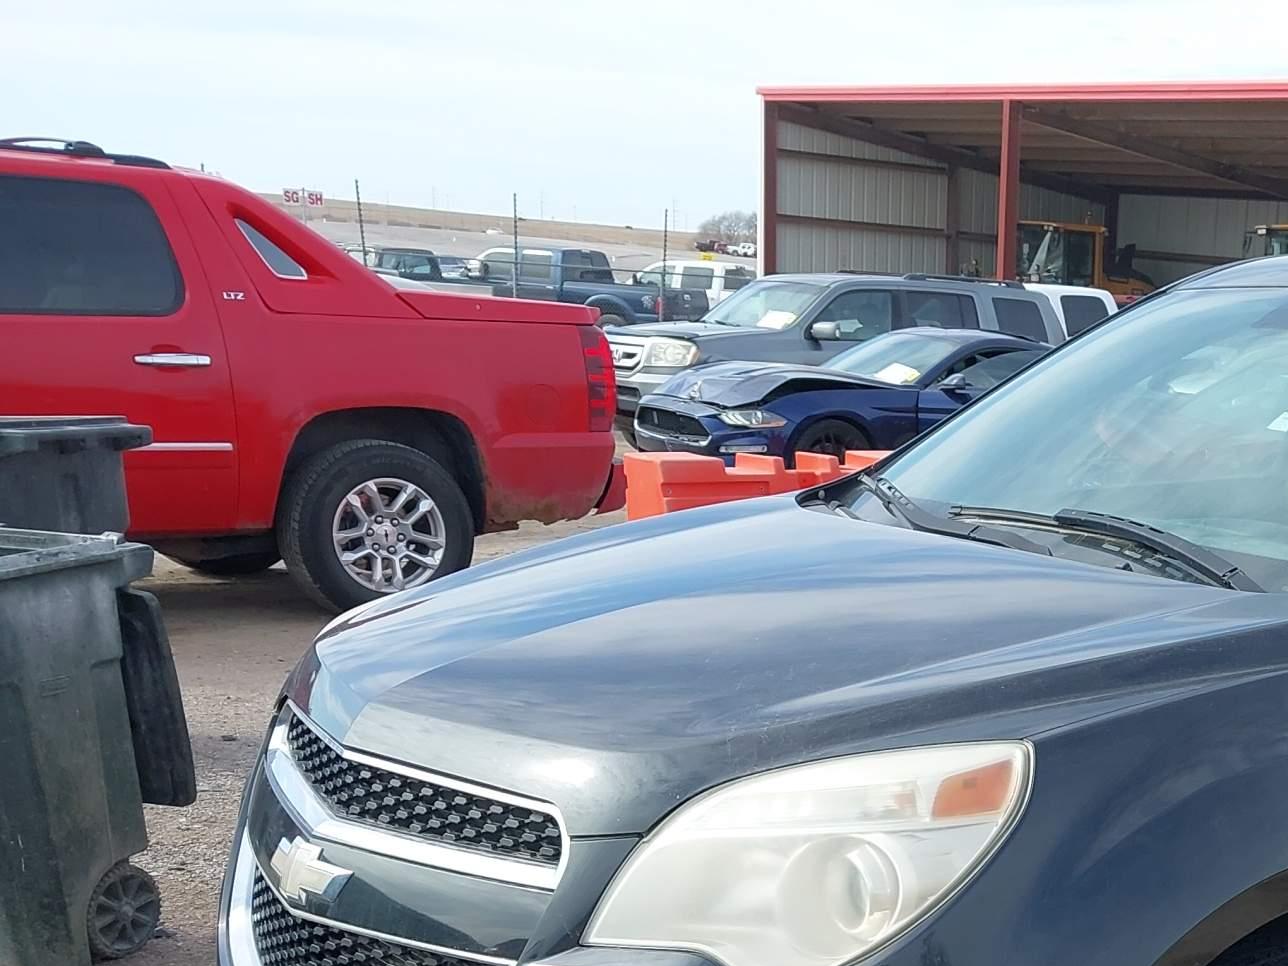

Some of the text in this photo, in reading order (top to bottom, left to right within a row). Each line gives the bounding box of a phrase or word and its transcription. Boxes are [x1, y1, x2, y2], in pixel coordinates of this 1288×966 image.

[283, 190, 300, 203] SG
[308, 192, 323, 205] SH
[222, 291, 246, 300] LTZ
